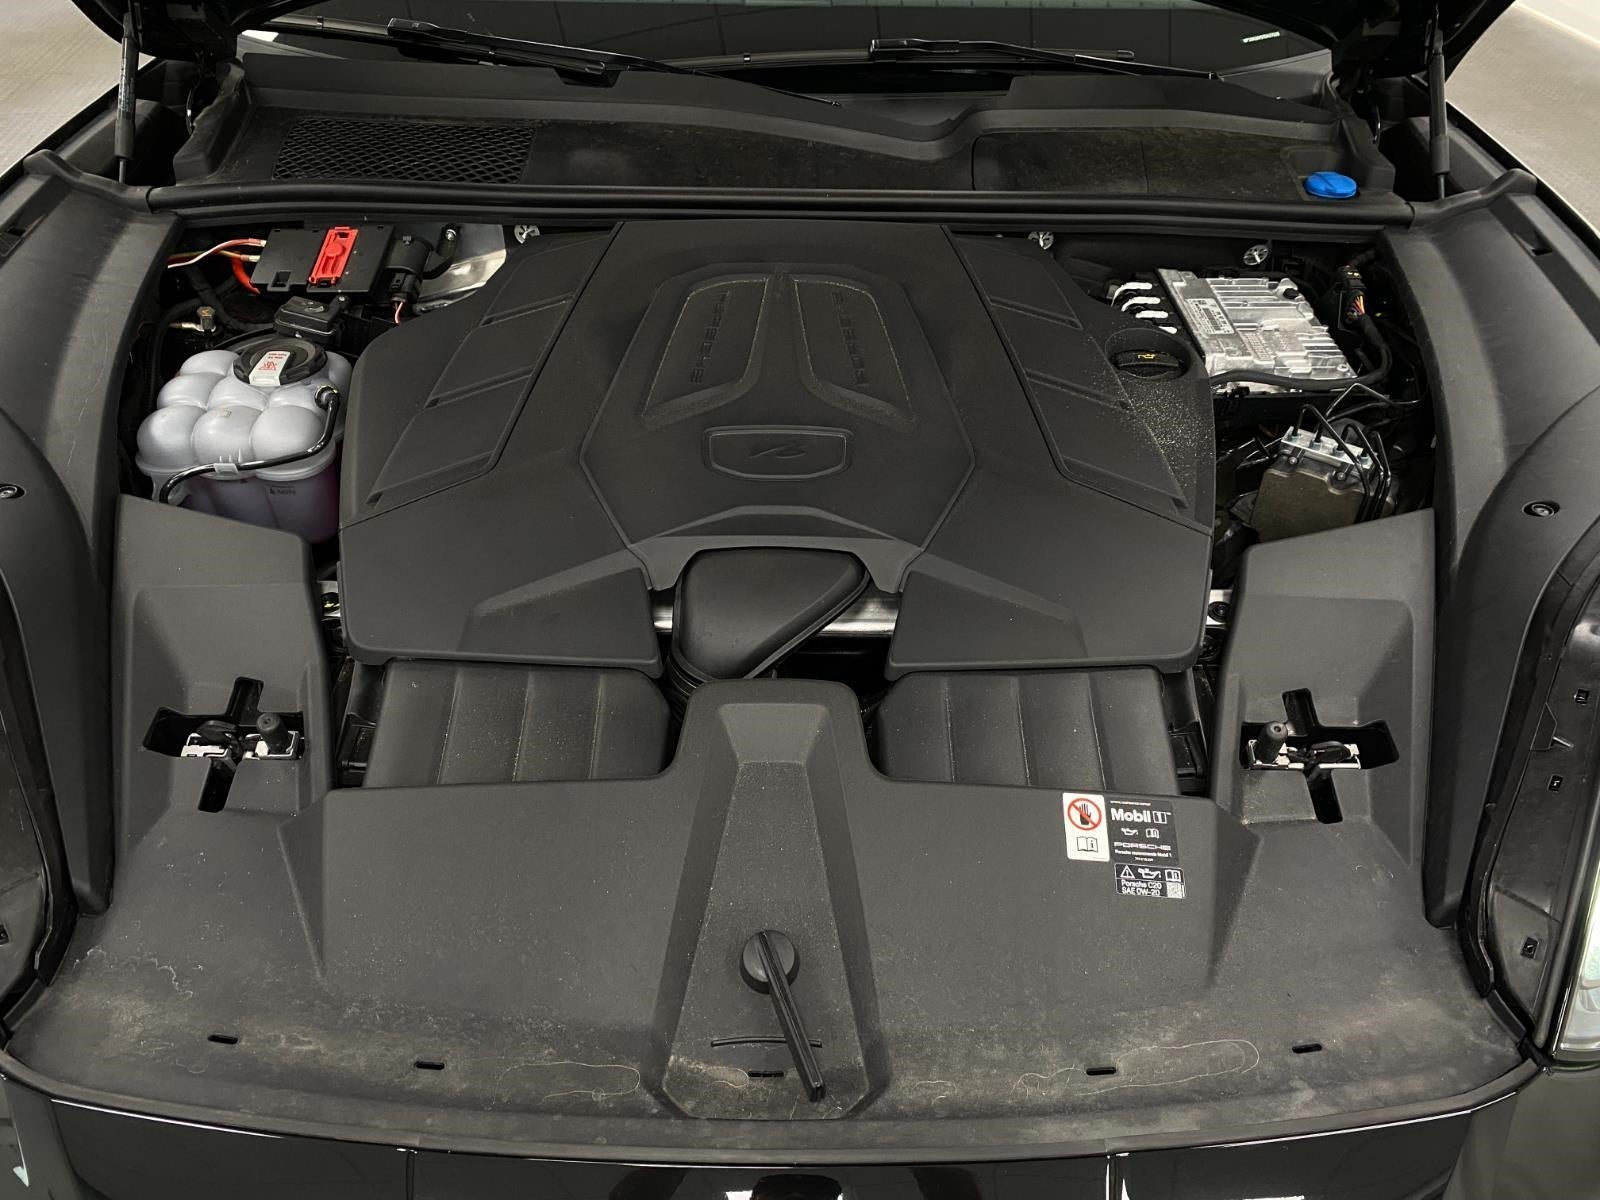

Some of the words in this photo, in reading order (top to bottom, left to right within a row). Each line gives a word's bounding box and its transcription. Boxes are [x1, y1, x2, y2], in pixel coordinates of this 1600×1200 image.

[1110, 807, 1151, 823] Mobil
[1113, 841, 1171, 851] PORSCHE
[1121, 879, 1147, 888] Porsche
[1148, 881, 1162, 890] C20
[1121, 886, 1136, 895] SAE
[1136, 887, 1161, 897] 0W-20
